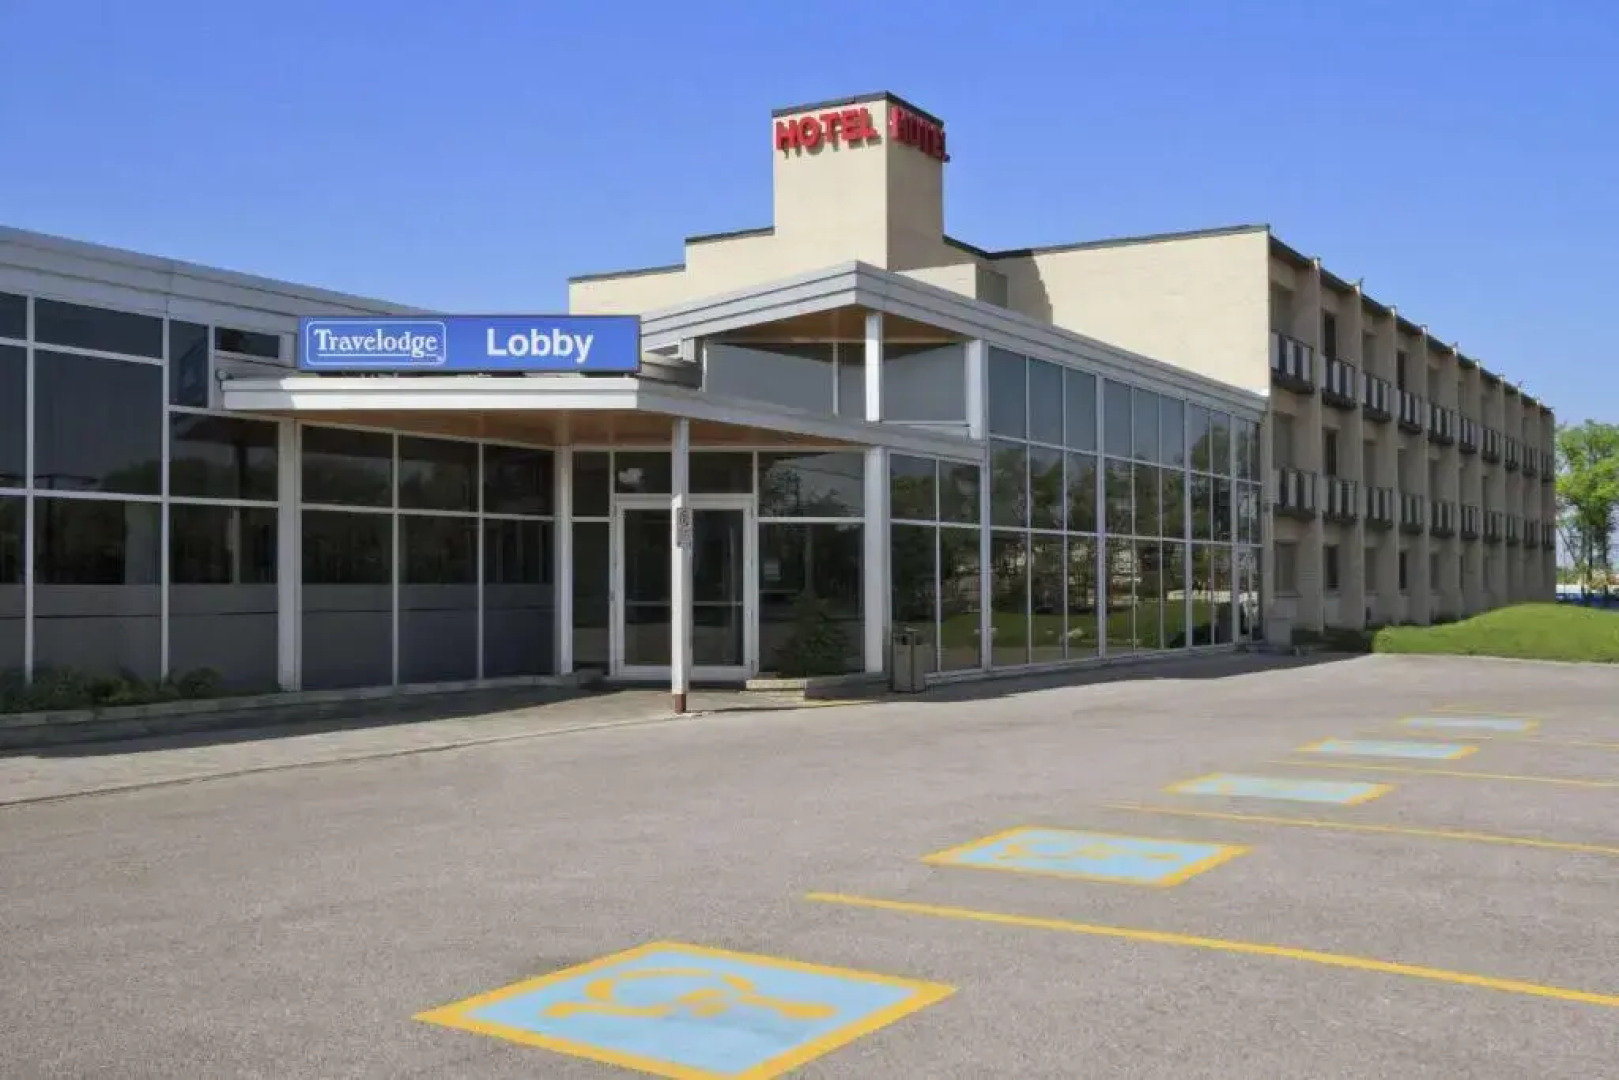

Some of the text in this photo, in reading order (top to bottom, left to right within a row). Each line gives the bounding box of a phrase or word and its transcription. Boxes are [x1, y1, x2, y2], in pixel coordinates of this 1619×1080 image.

[775, 107, 878, 151] HOTEL
[313, 328, 594, 364] Travelodge Lobby
